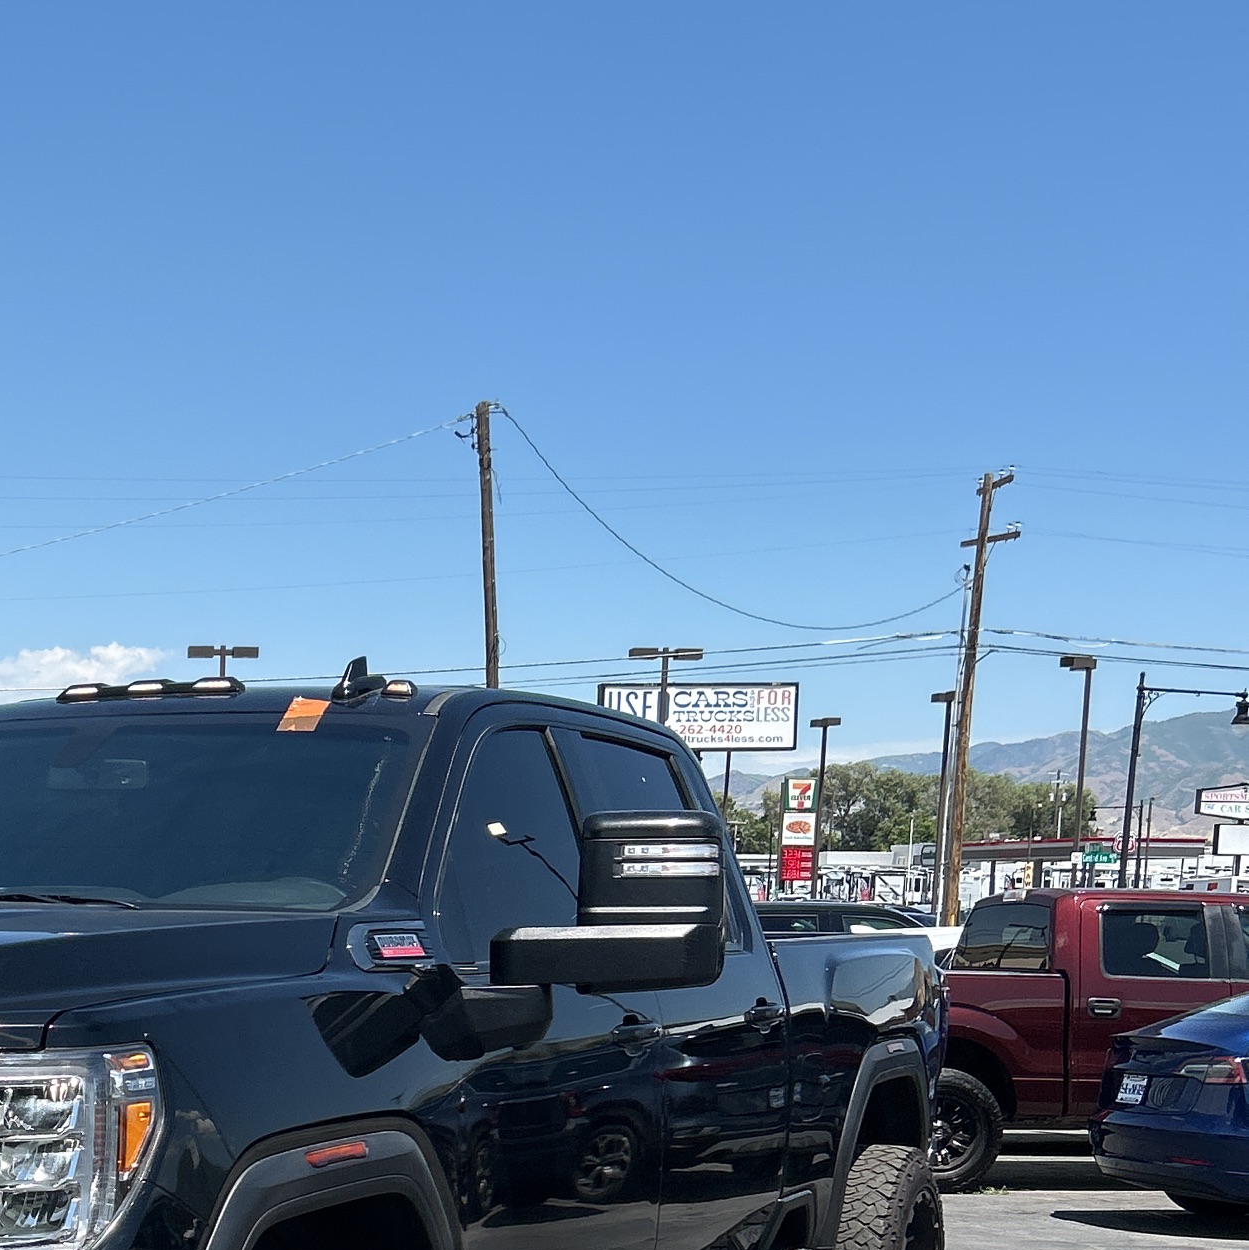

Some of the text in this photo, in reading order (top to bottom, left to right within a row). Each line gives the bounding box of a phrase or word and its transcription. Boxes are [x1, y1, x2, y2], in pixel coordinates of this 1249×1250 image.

[673, 691, 748, 708] CARS
[756, 690, 792, 706] FOR
[672, 707, 791, 723] TRUCKS LESS
[668, 724, 743, 735] -262-4420
[792, 783, 812, 809] 7
[1204, 790, 1249, 801] SPORTSM
[1220, 804, 1241, 813] CAR
